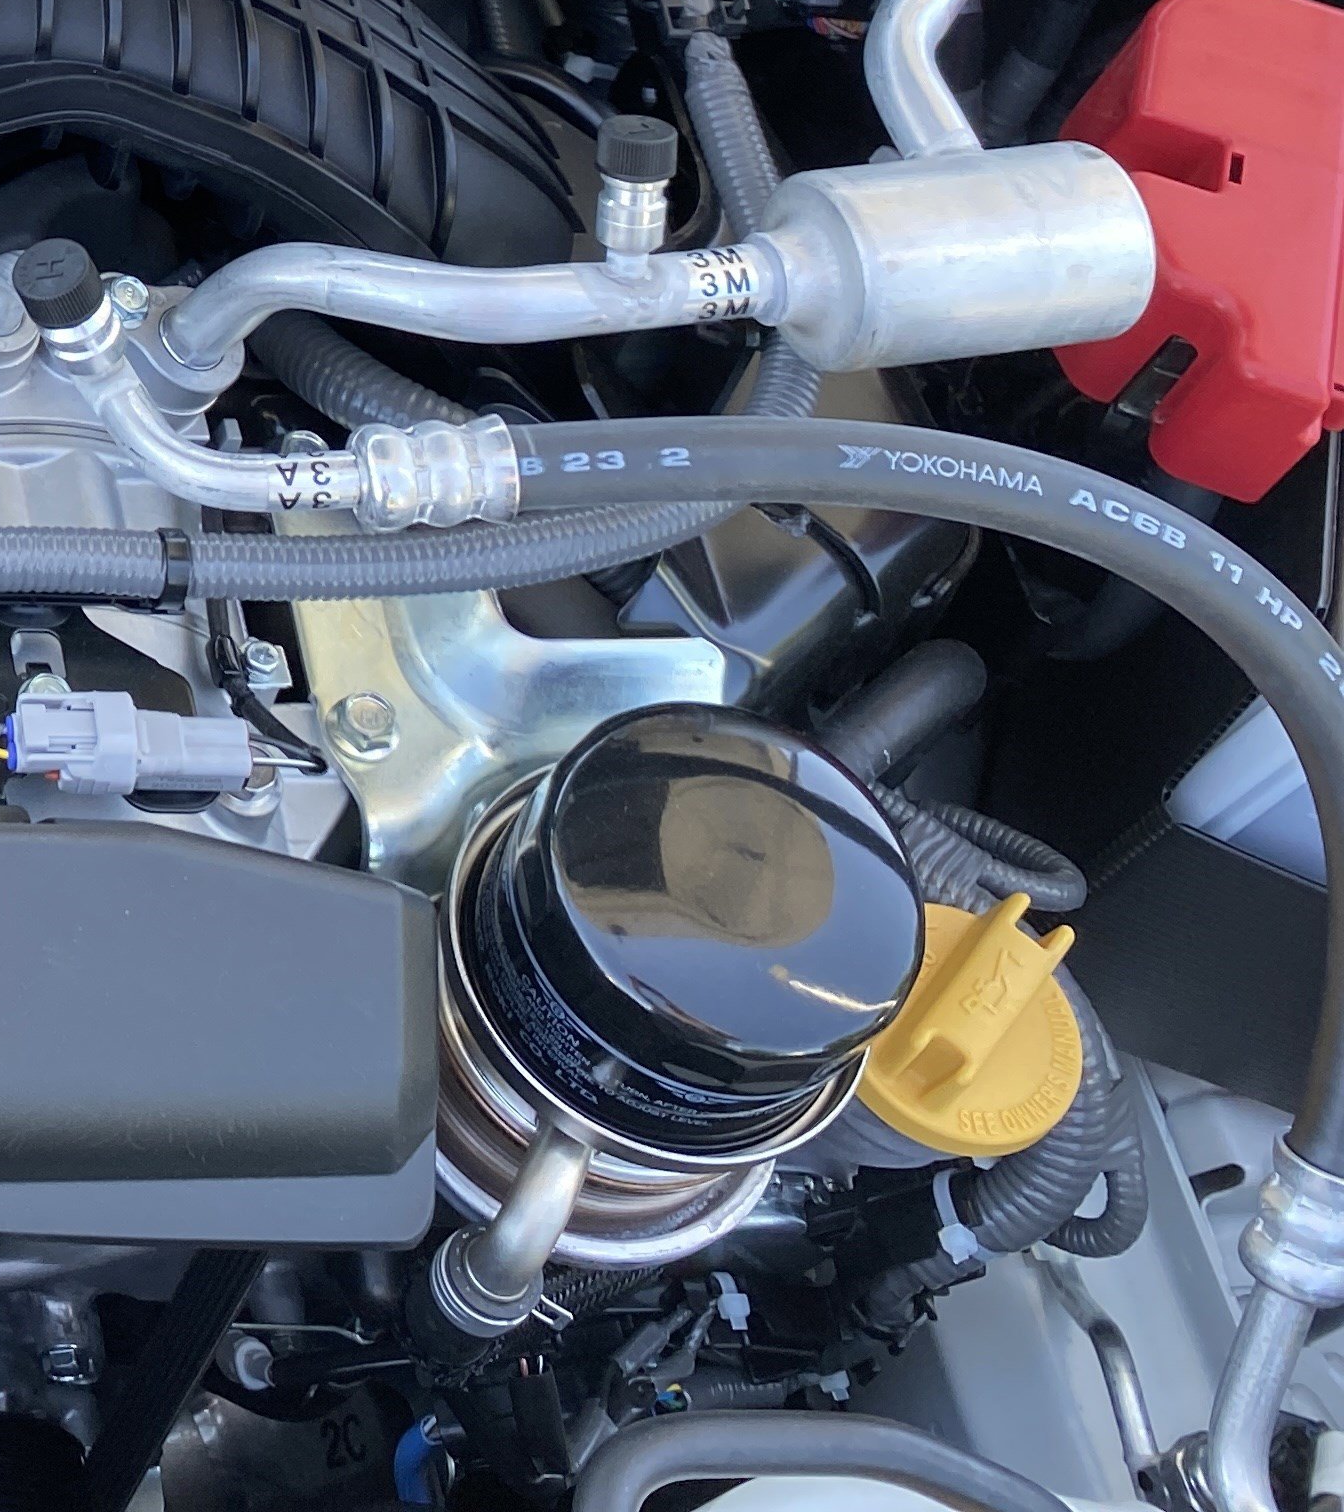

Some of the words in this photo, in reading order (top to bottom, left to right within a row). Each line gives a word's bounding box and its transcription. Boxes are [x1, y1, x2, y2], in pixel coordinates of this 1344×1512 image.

[699, 268, 752, 297] 3M
[560, 450, 626, 473] 23
[659, 446, 692, 468] 2
[885, 449, 1044, 497] YOKOHAMA
[1068, 489, 1188, 551] AC6B
[1255, 586, 1305, 631] HP
[520, 973, 581, 1048] CAUTION
[959, 1108, 1001, 1137] SEE
[1042, 991, 1080, 1076] MANUAL
